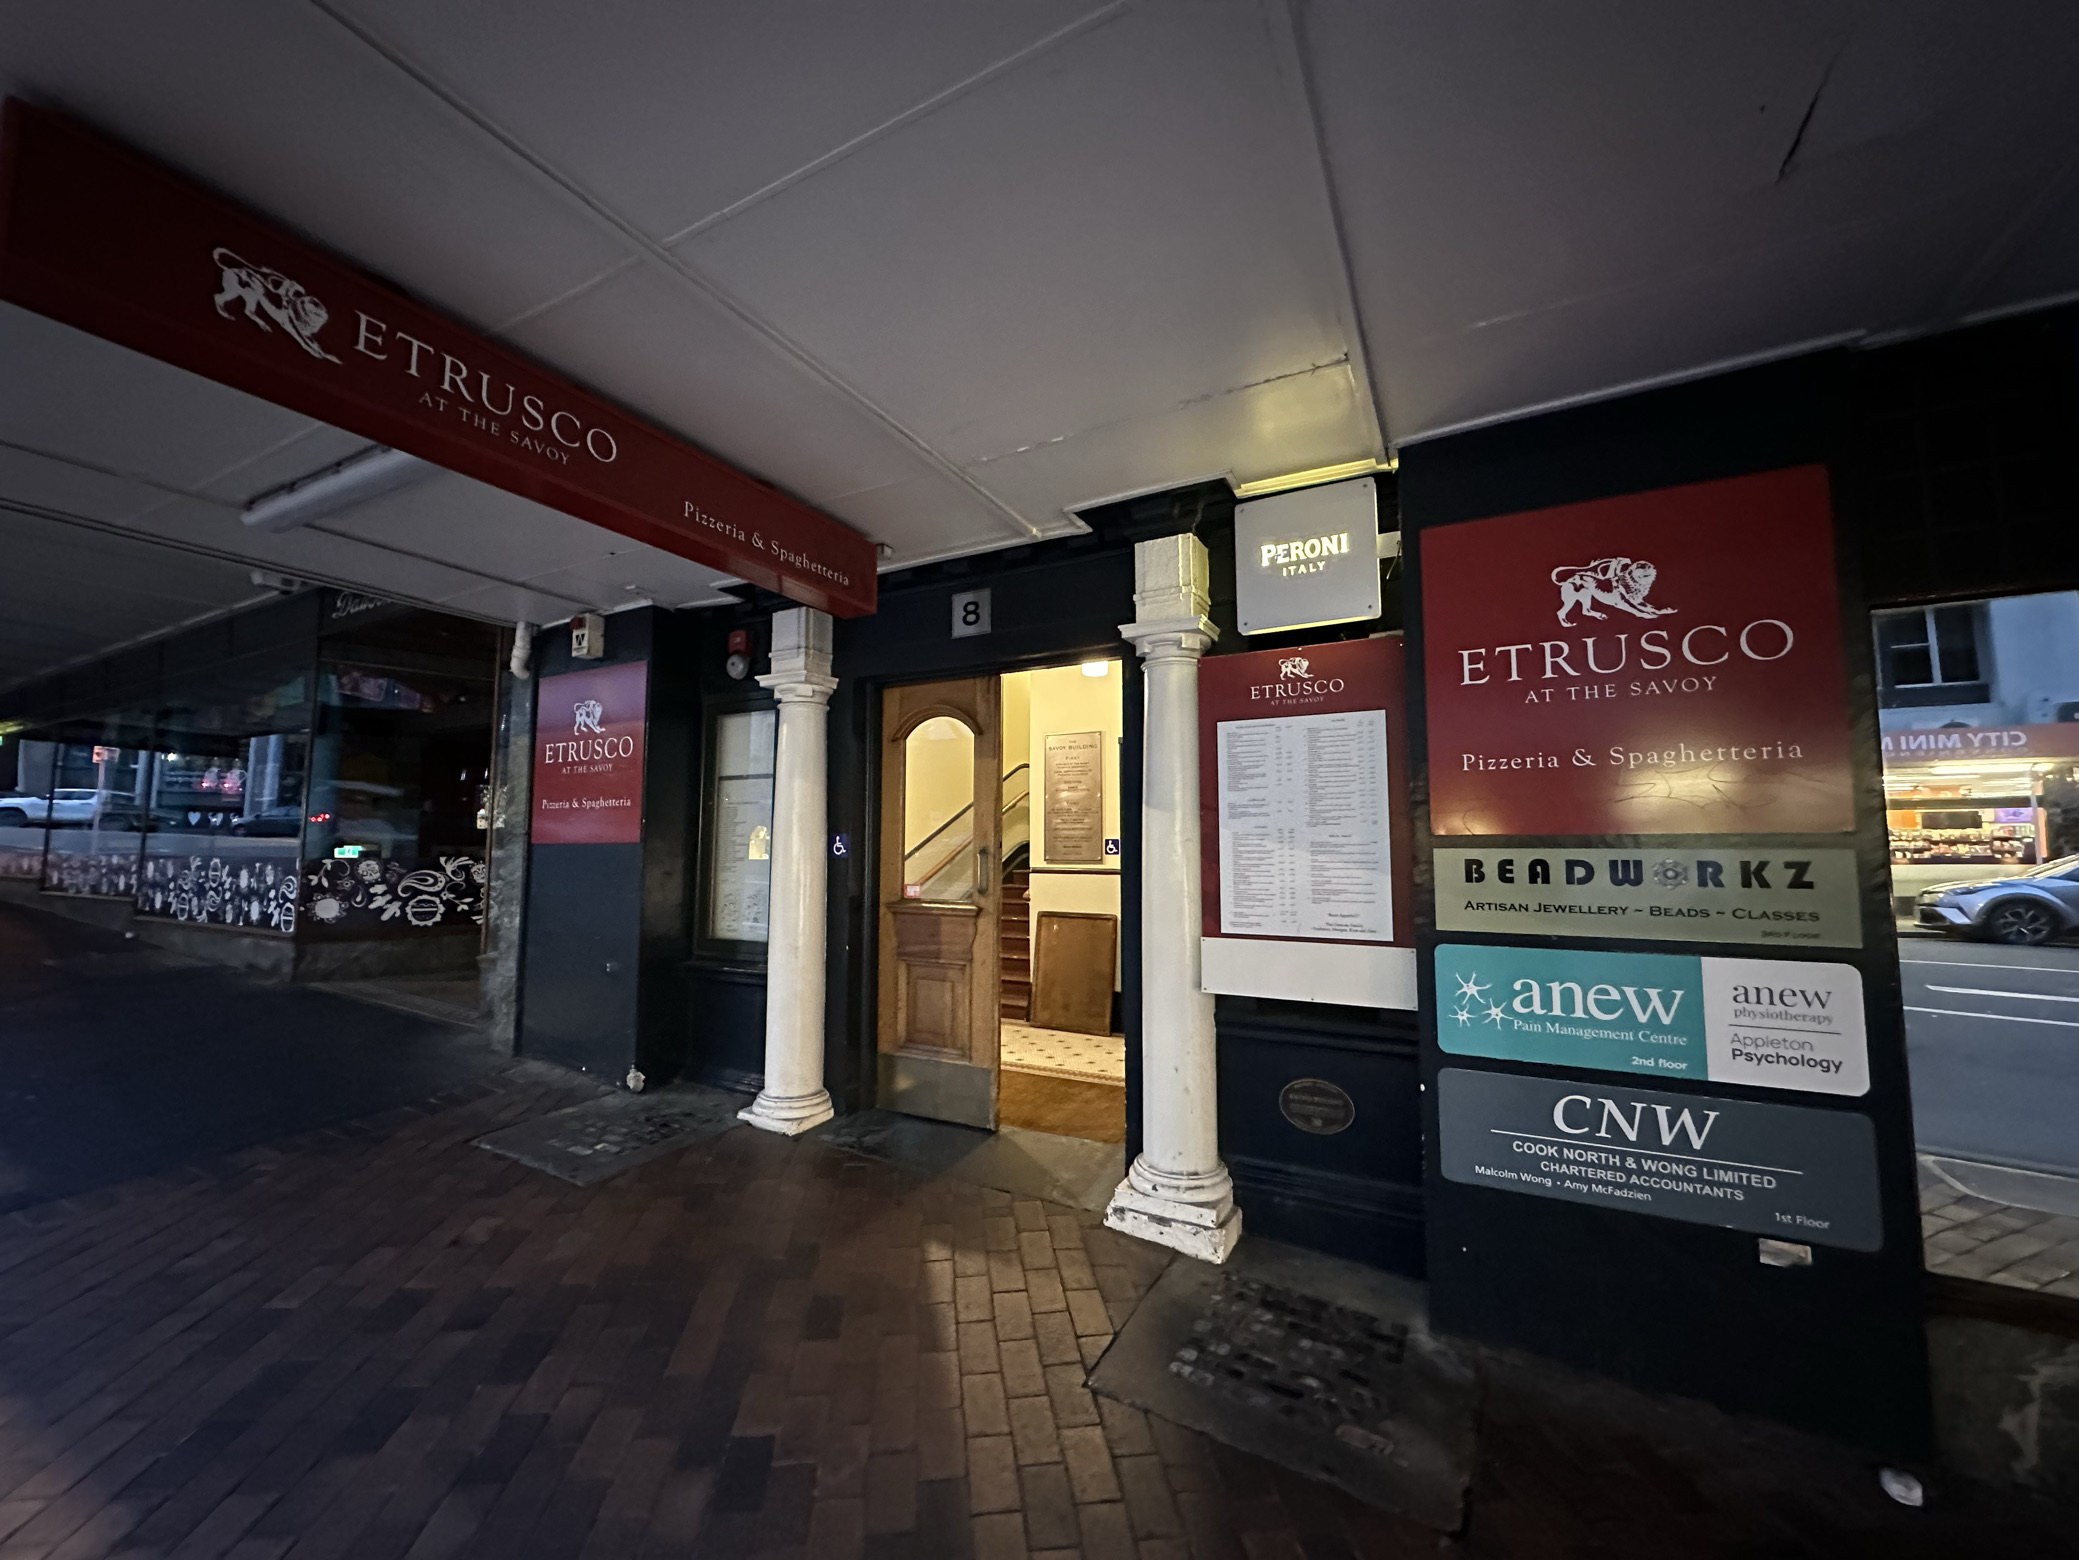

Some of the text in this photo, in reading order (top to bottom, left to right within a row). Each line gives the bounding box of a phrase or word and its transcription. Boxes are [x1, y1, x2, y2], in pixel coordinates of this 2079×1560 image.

[354, 309, 617, 463] ETRUSCO
[419, 392, 571, 465] AT THE SAVOY
[684, 501, 849, 586] Pizzeria & Spaghetteria
[1261, 532, 1350, 567] PERONI
[1282, 561, 1326, 577] ITALY
[962, 601, 980, 626] 8
[1458, 619, 1794, 685] ETRUSCO
[1250, 678, 1344, 699] ETRUSCO
[1283, 697, 1297, 705] THE
[1300, 696, 1324, 704] SAVOY
[1525, 676, 1717, 703] AT THE SAVOY
[545, 736, 634, 763] ETRUSCO
[1462, 741, 1804, 771] Pizzeria & Spaghetteria
[574, 765, 587, 773] THE
[590, 763, 613, 773] SAVOY
[542, 797, 631, 810] Pizzeria & Spaghetteria
[1464, 901, 1529, 913] ARTISAN
[1533, 902, 1629, 916] JEWELLERY
[1650, 906, 1710, 918] BEADS
[1732, 908, 1820, 922] CLASSES
[1512, 978, 1685, 1026] anew
[1732, 984, 1832, 1009] anew
[1734, 1006, 1833, 1026] physiotherapy
[1513, 1019, 1687, 1046] Pain Management Centre
[1730, 1033, 1814, 1052] Appleton
[1632, 1056, 1688, 1070] 2nd floor
[1731, 1048, 1843, 1074] Psychology
[1553, 1095, 1720, 1150] CNW
[1512, 1140, 1777, 1189] COOK NORTH & WONG LIMITED
[1475, 1165, 1652, 1201] Malcolm Wong Amy McFadzien
[1540, 1160, 1744, 1201] CHARTERED ACCOUNTANTS
[1774, 1212, 1831, 1229] 1st Floor
